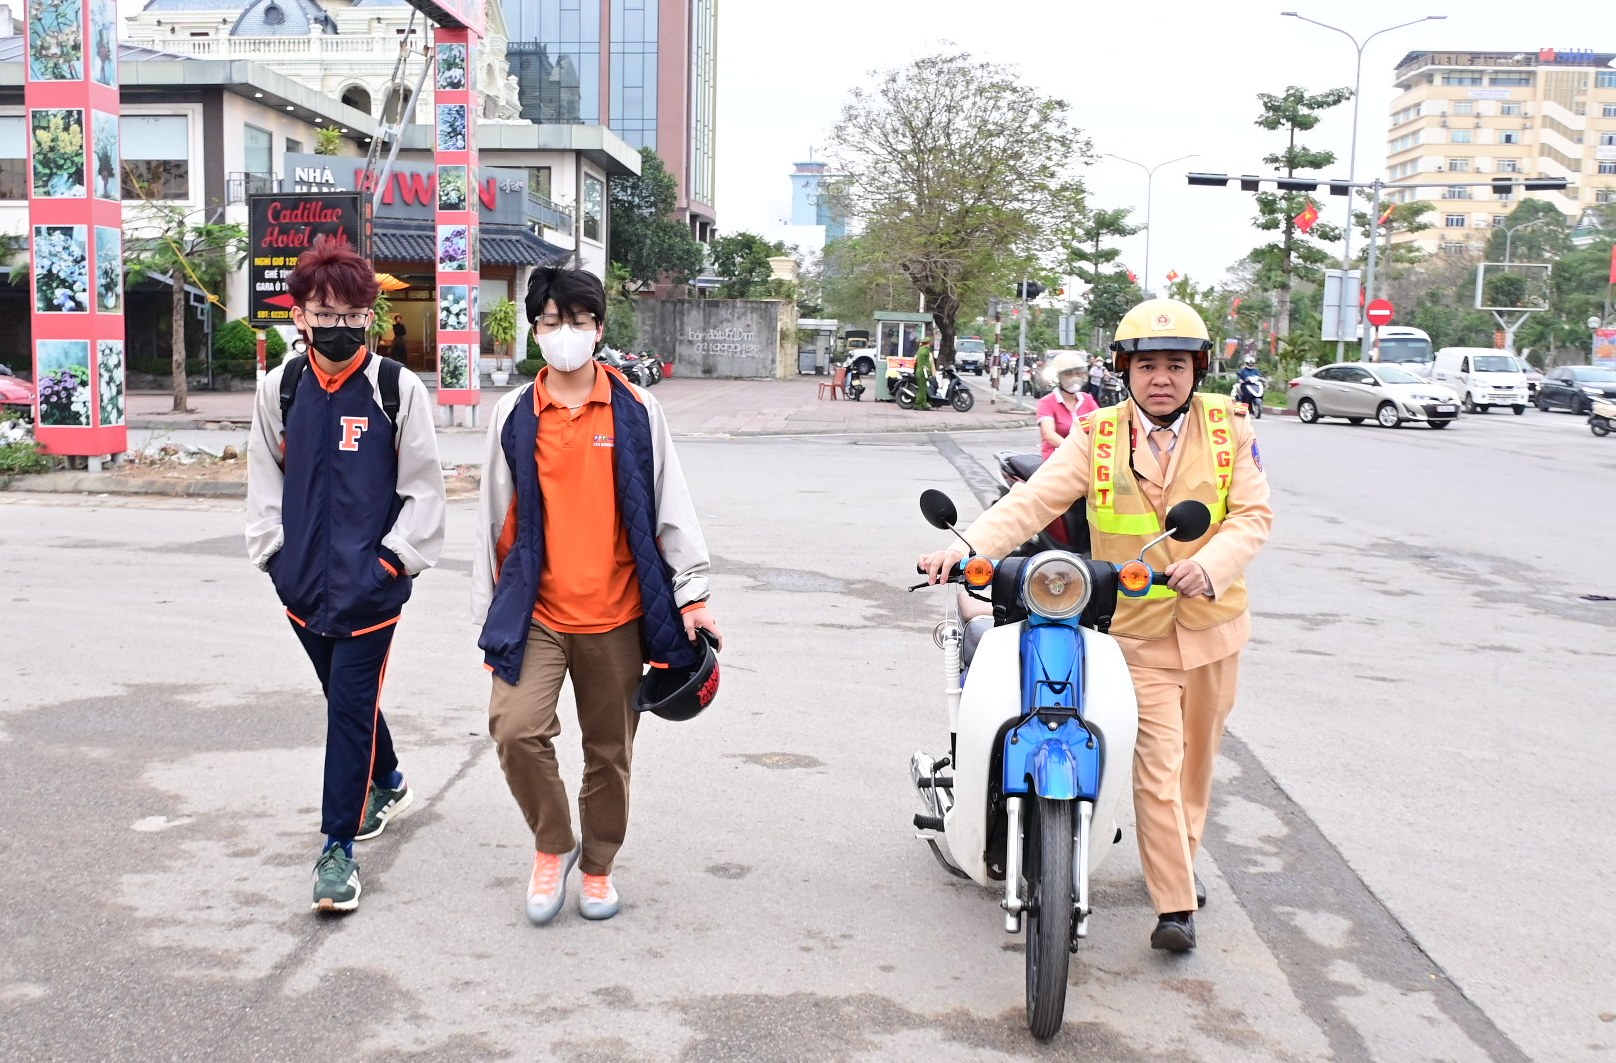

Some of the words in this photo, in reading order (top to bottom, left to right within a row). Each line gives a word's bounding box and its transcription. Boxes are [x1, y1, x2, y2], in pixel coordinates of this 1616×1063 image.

[295, 166, 335, 184] NHÀ
[354, 169, 497, 212] BIWN
[267, 200, 343, 224] Cadillac
[261, 226, 312, 248] Hotel
[339, 416, 368, 451] F
[1208, 408, 1231, 489] CSGT
[1096, 420, 1114, 505] CSGT
